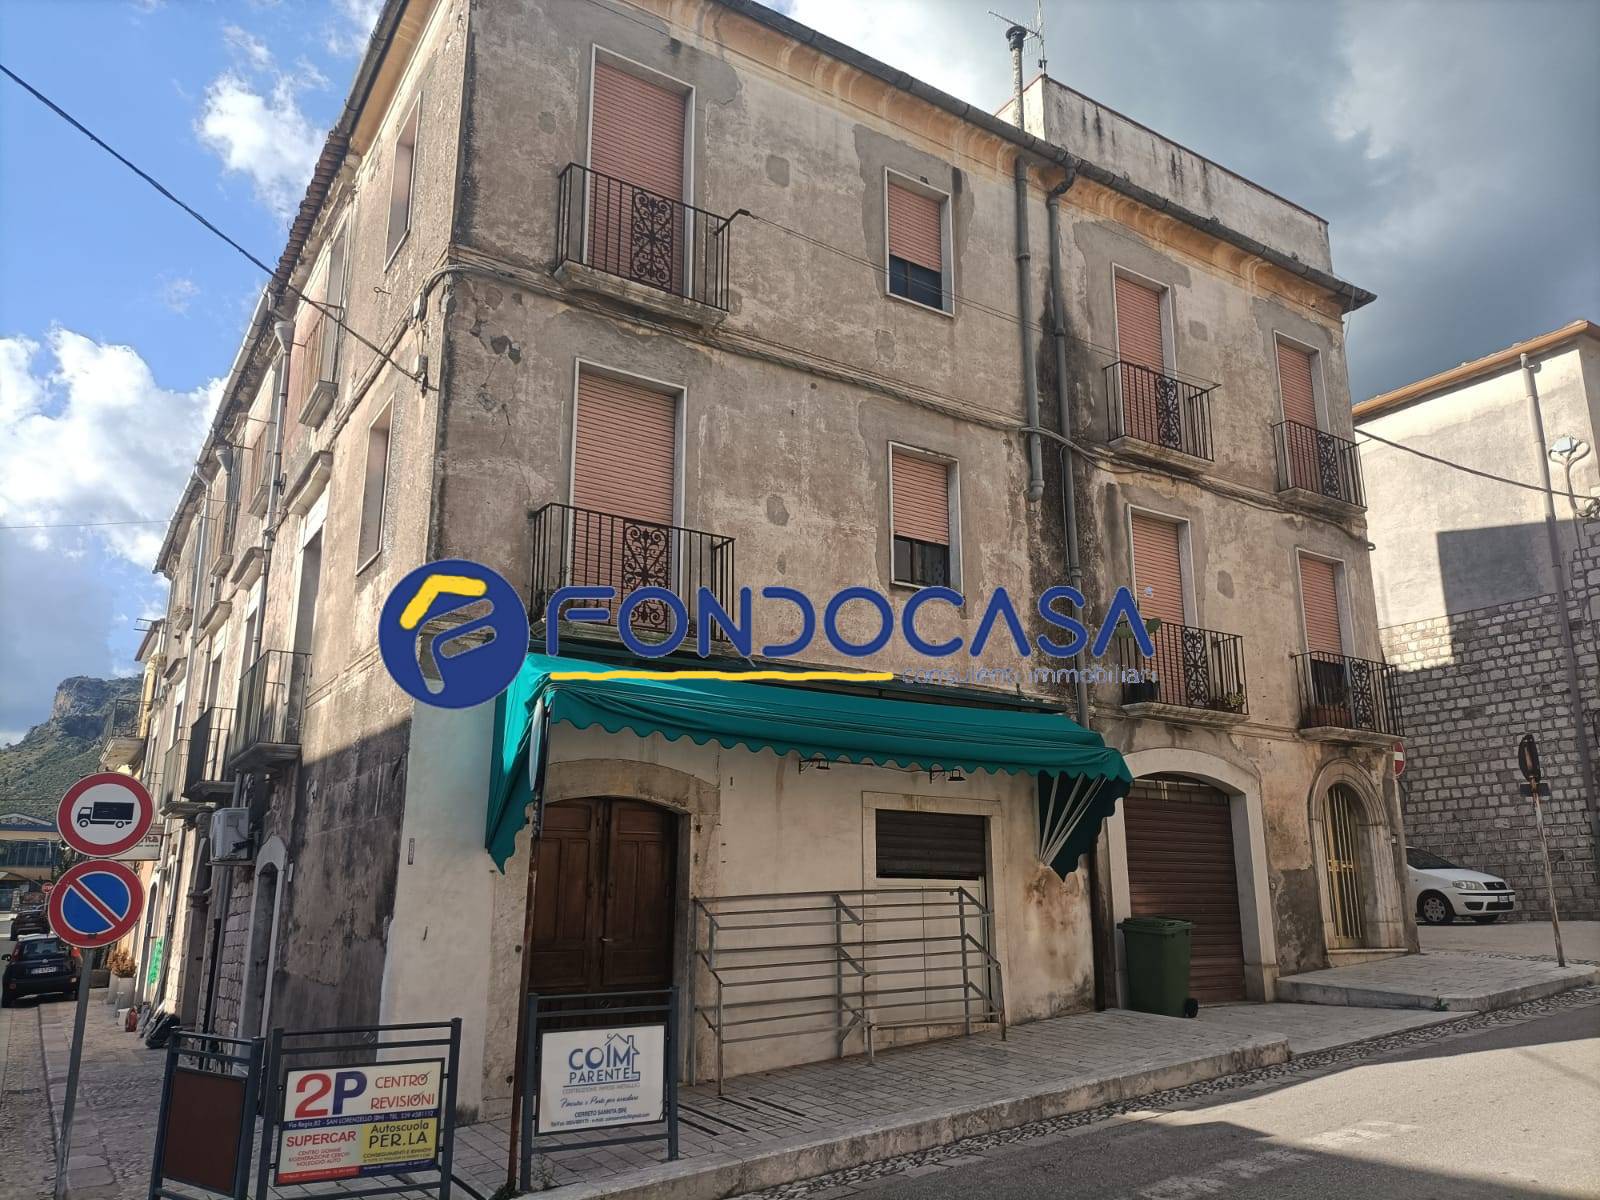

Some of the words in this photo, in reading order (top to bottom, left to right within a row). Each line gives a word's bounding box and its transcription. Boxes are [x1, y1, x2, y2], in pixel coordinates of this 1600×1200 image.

[568, 1043, 632, 1070] COIM
[375, 1072, 430, 1089] CENTRO
[569, 1067, 630, 1084] PARENTE
[294, 1070, 368, 1119] 2P
[370, 1092, 435, 1110] REVISIONI
[326, 1117, 337, 1126] SAN
[371, 1121, 430, 1134] Autoscuola
[286, 1131, 357, 1148] SUPERCAR
[369, 1132, 428, 1149] PER.LA
